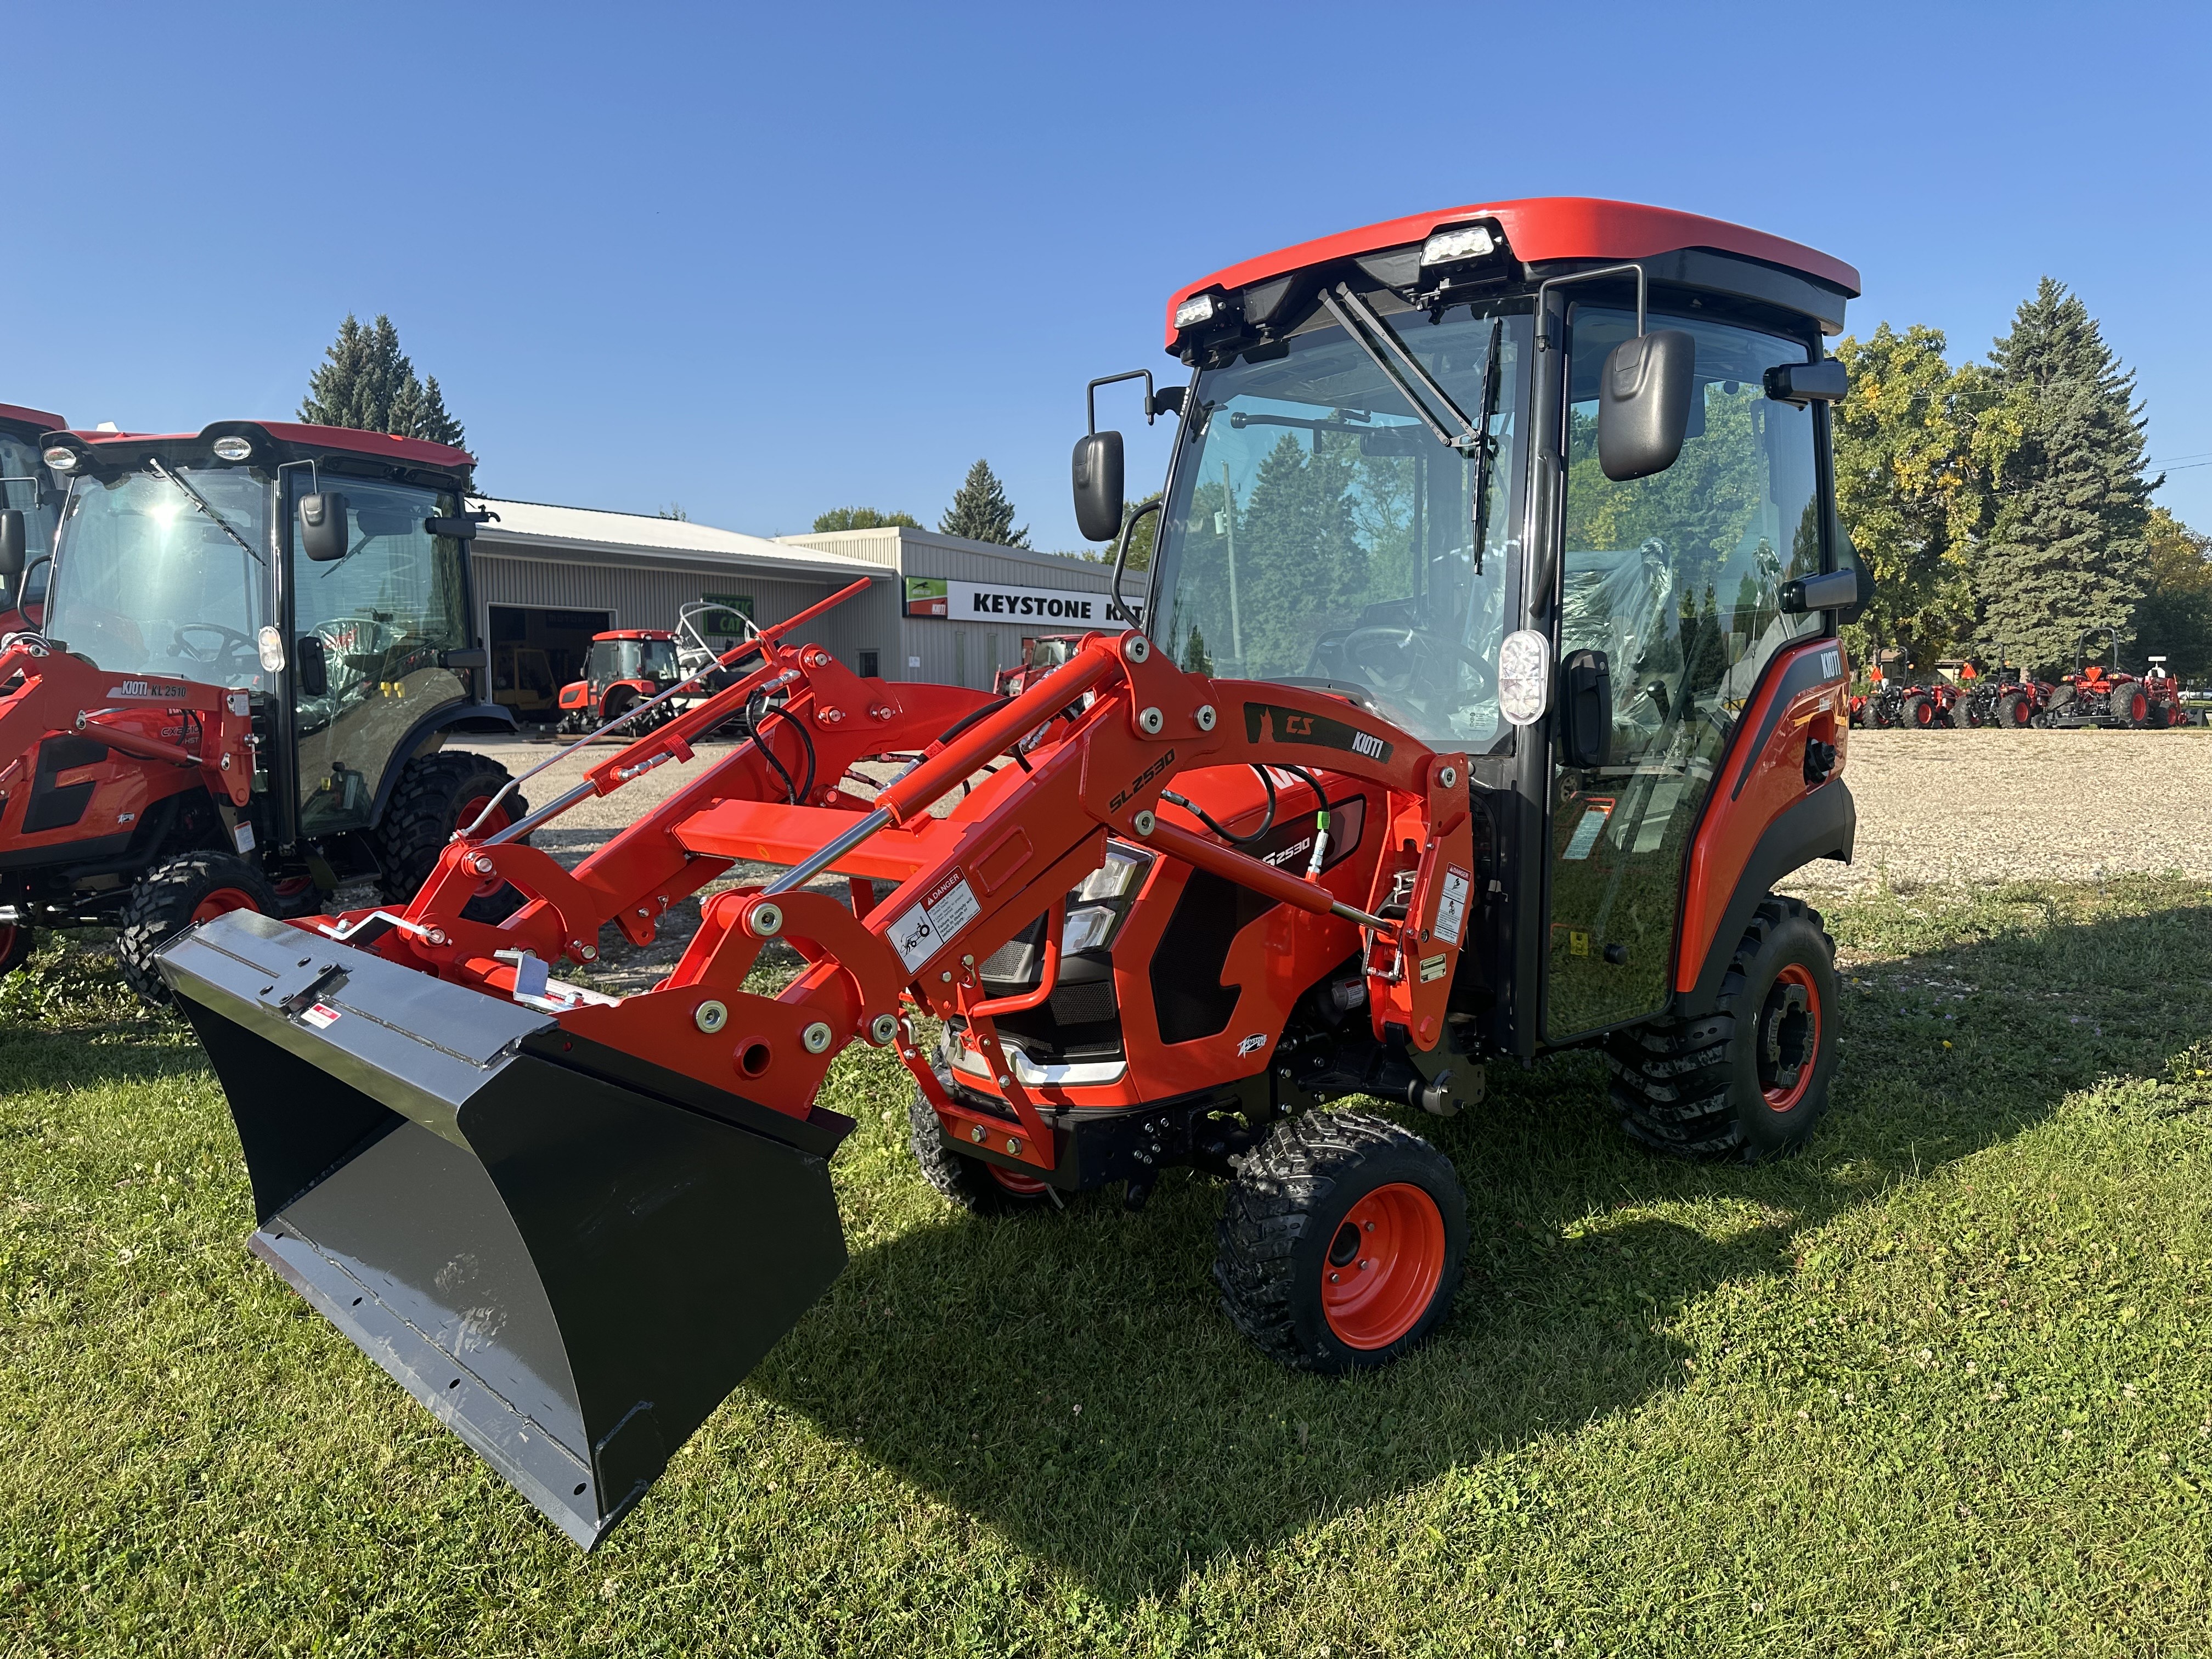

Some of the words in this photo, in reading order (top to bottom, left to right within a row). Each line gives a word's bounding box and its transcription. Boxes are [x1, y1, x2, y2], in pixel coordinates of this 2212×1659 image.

[974, 592, 1091, 619] KEYSTONE
[1106, 603, 1143, 621] KT
[720, 616, 741, 632] CAT
[1820, 650, 1841, 679] KIOTI
[122, 680, 148, 696] KIOTI
[151, 685, 162, 696] KL
[165, 686, 187, 697] 2510
[1286, 715, 1314, 736] CS
[1352, 731, 1384, 759] KIOTI
[1109, 748, 1175, 814] SL2530
[1260, 837, 1310, 866] S2530
[933, 873, 960, 899] DANGER
[1453, 867, 1469, 879] DANGER
